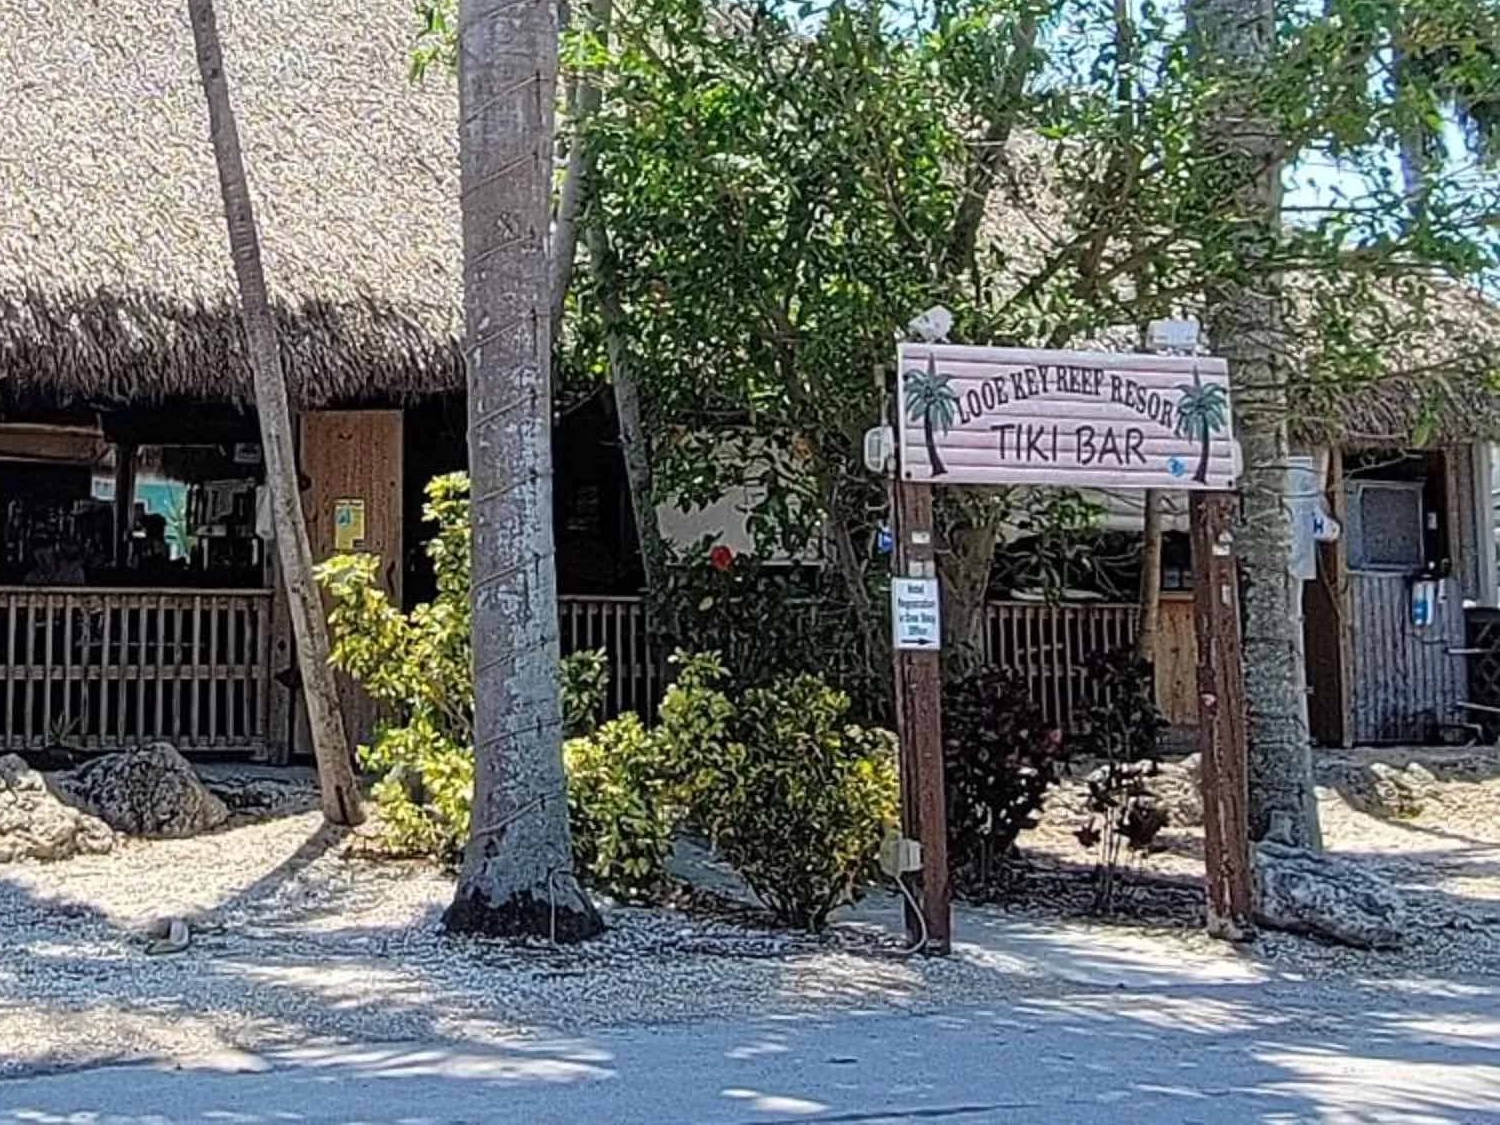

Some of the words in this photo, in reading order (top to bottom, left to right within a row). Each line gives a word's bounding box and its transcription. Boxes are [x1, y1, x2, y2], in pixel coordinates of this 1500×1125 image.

[954, 376, 1008, 424] LOOE
[1010, 365, 1050, 401] KEY
[1056, 365, 1104, 396] REEF
[990, 423, 1057, 462] TIKI
[1076, 425, 1147, 465] BAR
